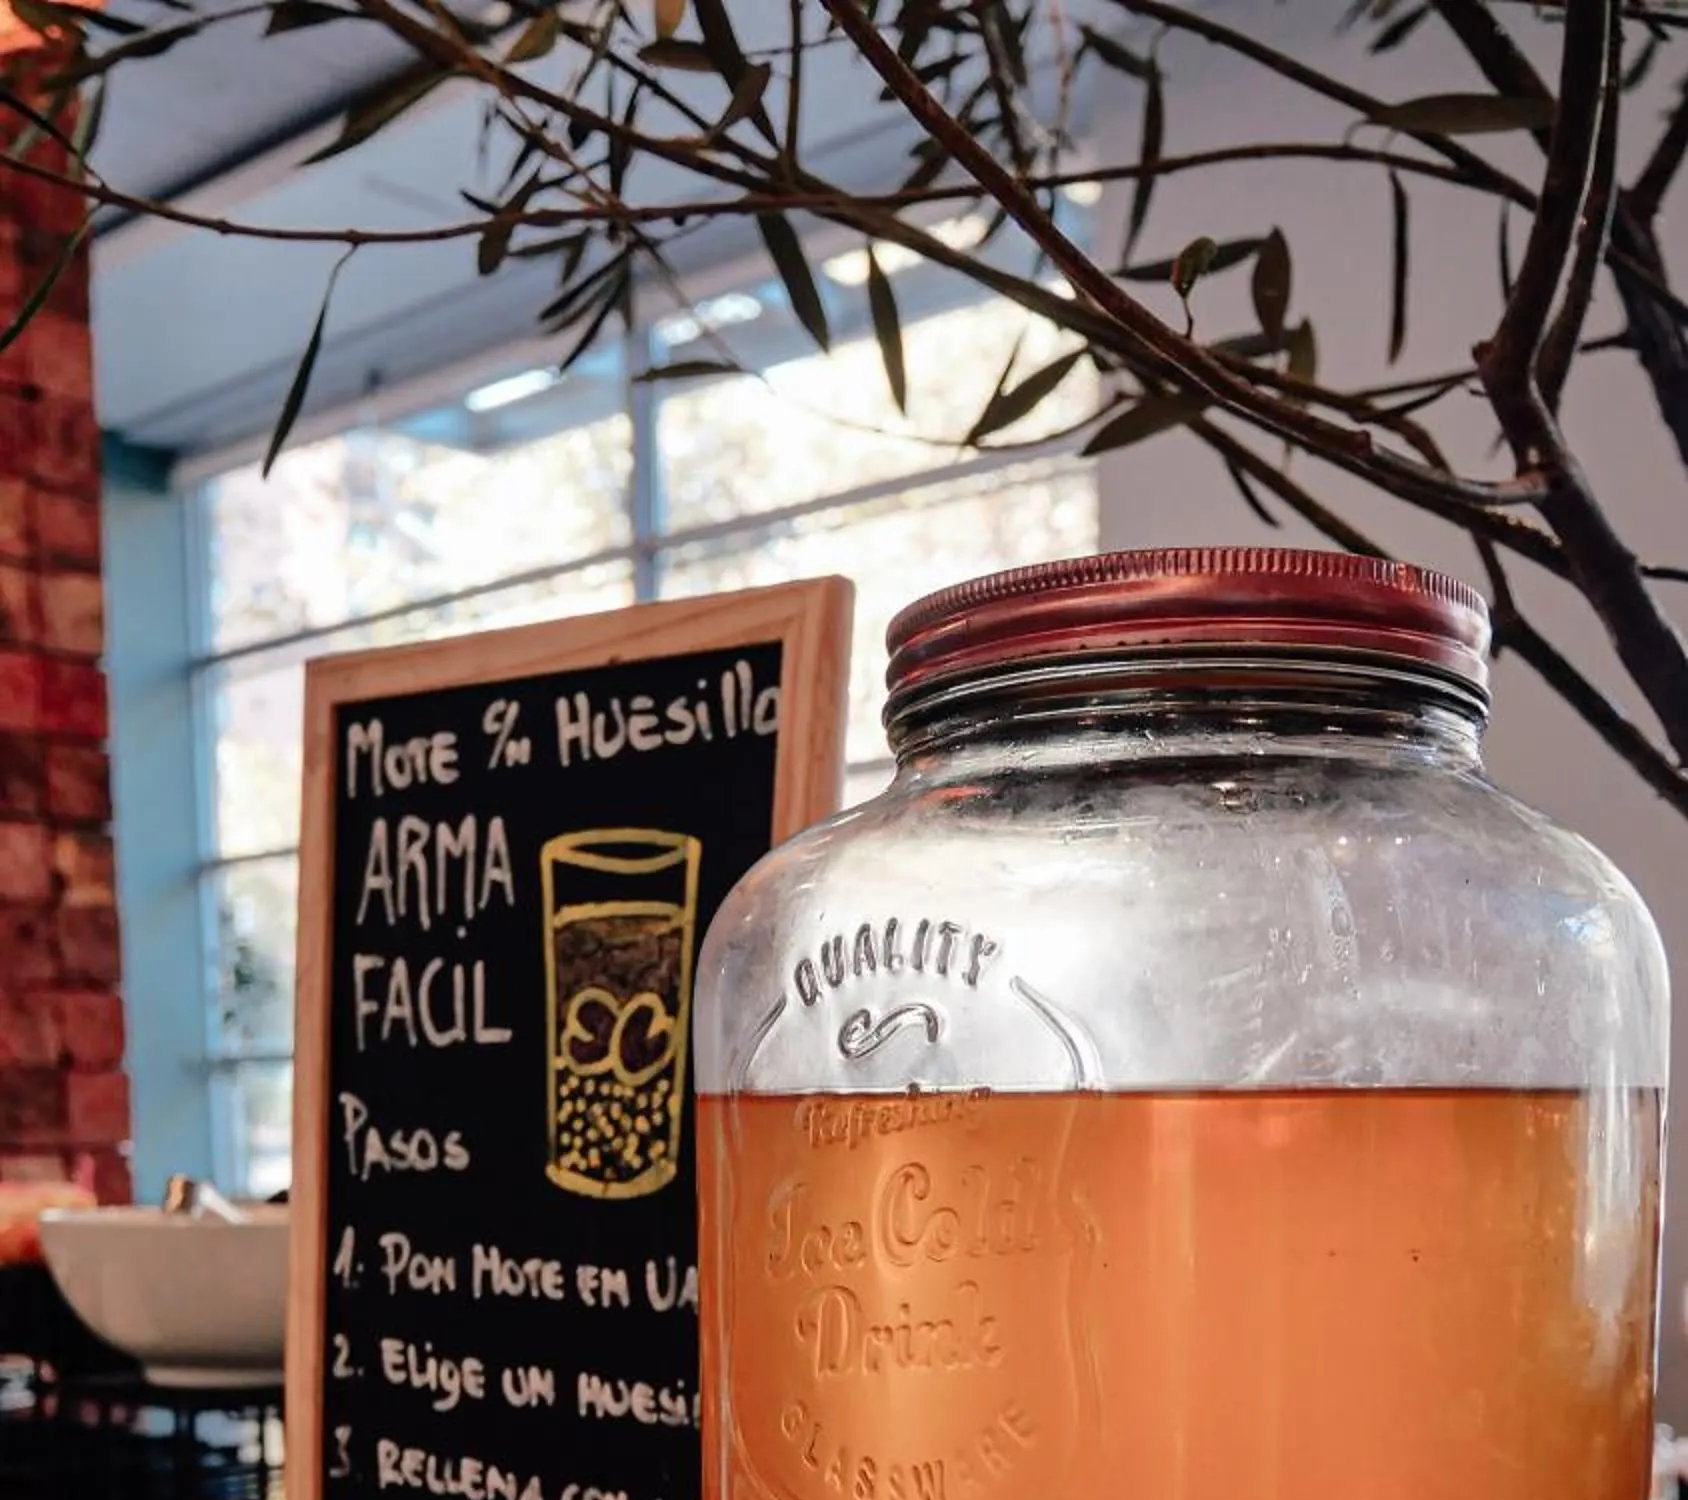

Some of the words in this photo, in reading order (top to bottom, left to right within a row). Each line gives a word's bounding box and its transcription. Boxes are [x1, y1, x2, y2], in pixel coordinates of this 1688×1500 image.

[356, 813, 515, 930] ARMA
[794, 917, 999, 1007] QUALITY
[502, 1365, 555, 1408] UN
